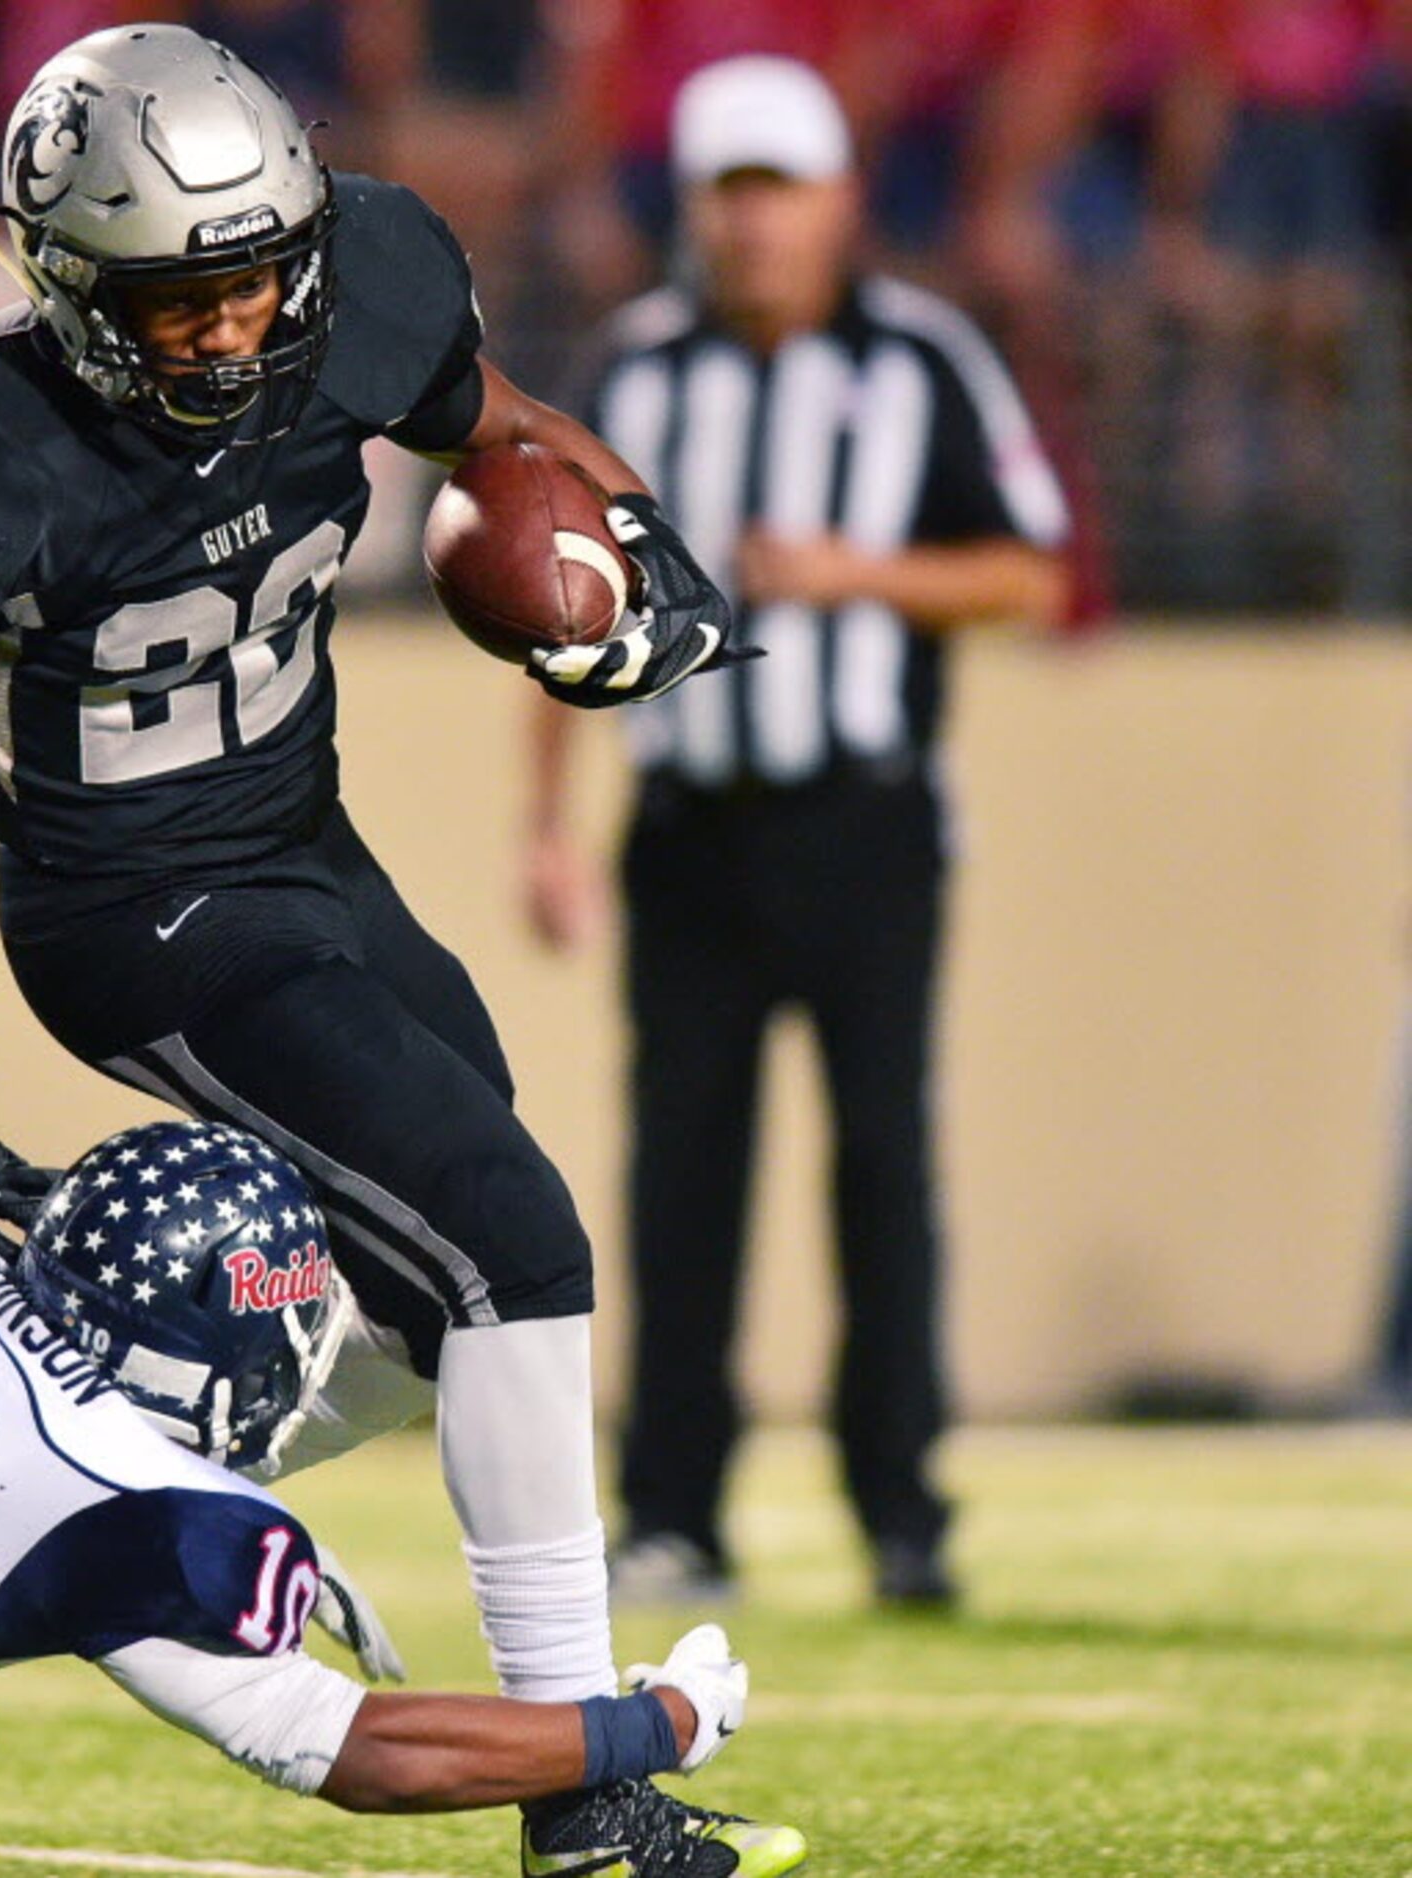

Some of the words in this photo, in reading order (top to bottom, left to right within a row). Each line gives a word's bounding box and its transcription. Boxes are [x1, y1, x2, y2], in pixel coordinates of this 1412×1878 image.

[198, 213, 275, 247] Riddell
[200, 503, 272, 566] GUYER
[80, 519, 346, 784] 22
[79, 1320, 111, 1354] 10
